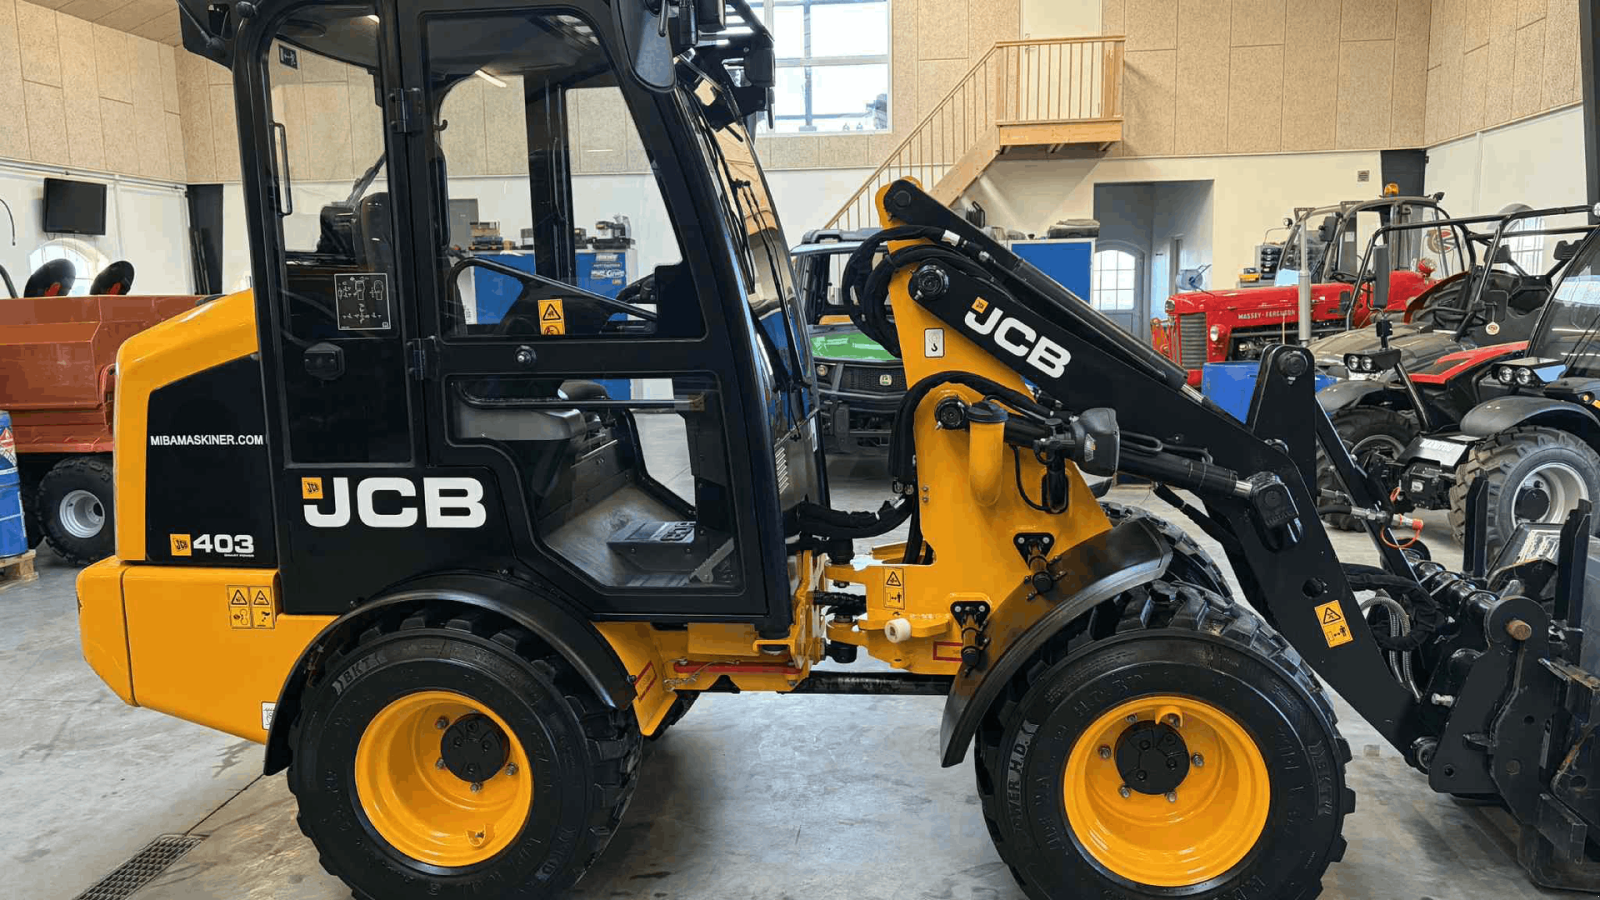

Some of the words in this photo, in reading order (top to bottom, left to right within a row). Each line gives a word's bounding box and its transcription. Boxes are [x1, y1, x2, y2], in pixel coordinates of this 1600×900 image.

[964, 307, 1071, 379] JCB
[150, 434, 264, 446] MIBAMASKINER.COM
[303, 477, 487, 528] JCB
[193, 533, 255, 554] 403
